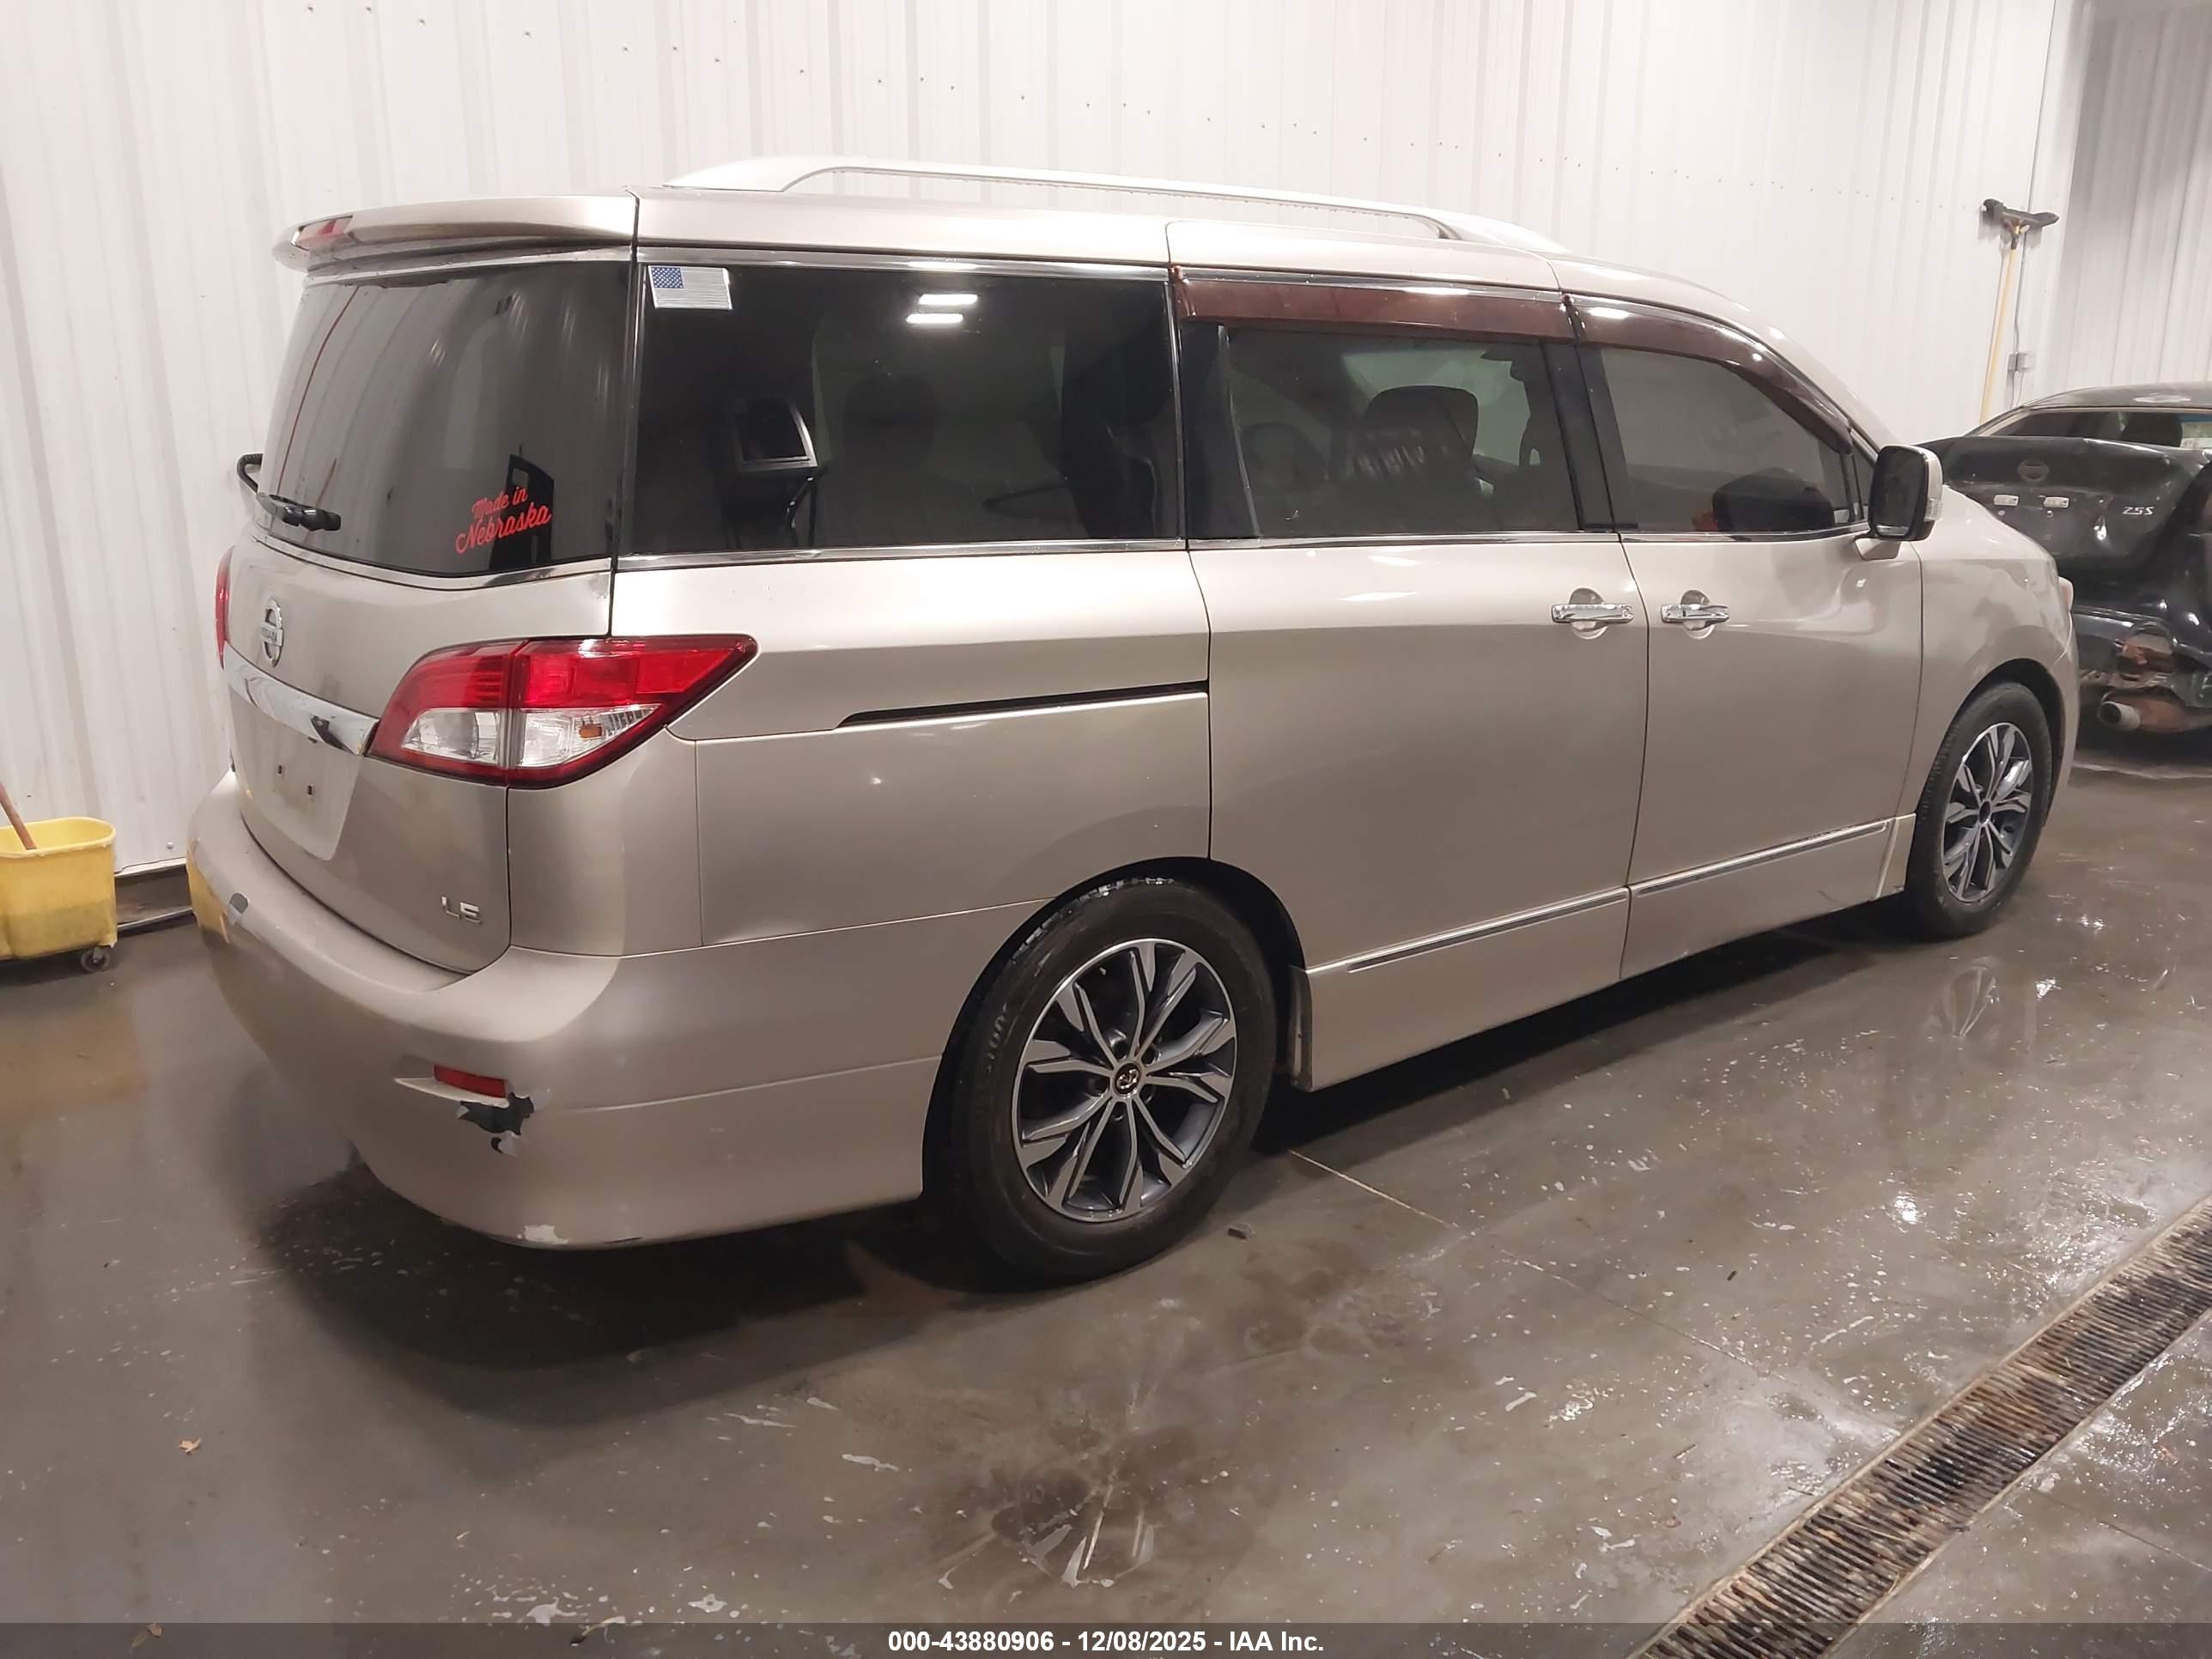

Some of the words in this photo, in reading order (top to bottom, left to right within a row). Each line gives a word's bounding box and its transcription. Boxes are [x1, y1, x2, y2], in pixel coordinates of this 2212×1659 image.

[472, 492, 509, 520] Made
[513, 486, 528, 505] in
[456, 502, 551, 553] Nebraska
